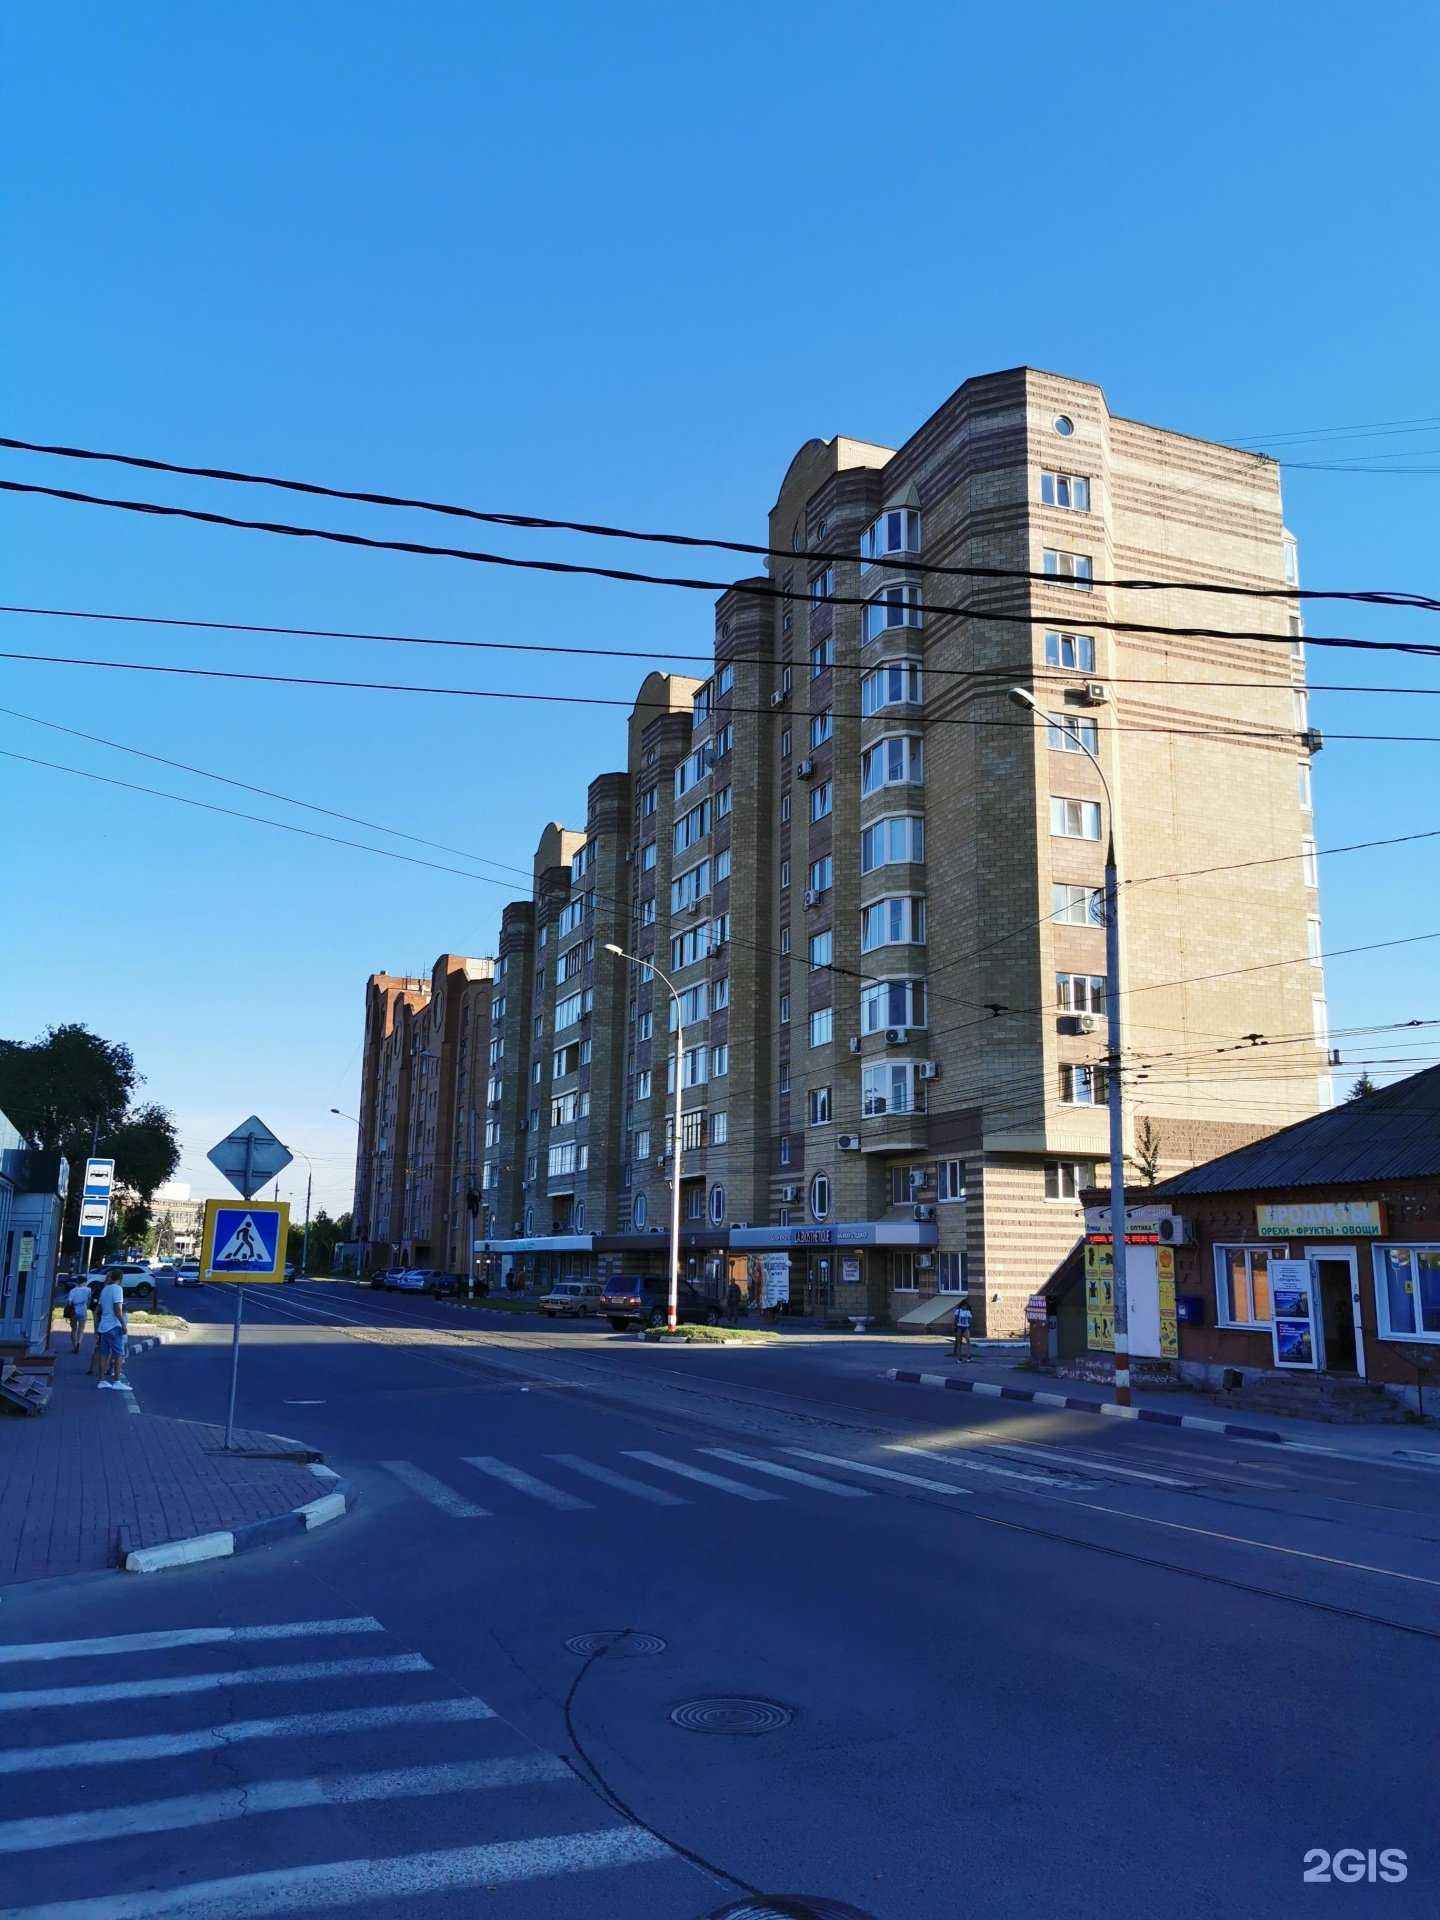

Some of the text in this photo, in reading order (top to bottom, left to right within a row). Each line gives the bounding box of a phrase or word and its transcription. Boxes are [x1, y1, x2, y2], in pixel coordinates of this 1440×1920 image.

[1261, 1224, 1379, 1235] ОРЕХИ ФРУКТЫ ОВОЩИ
